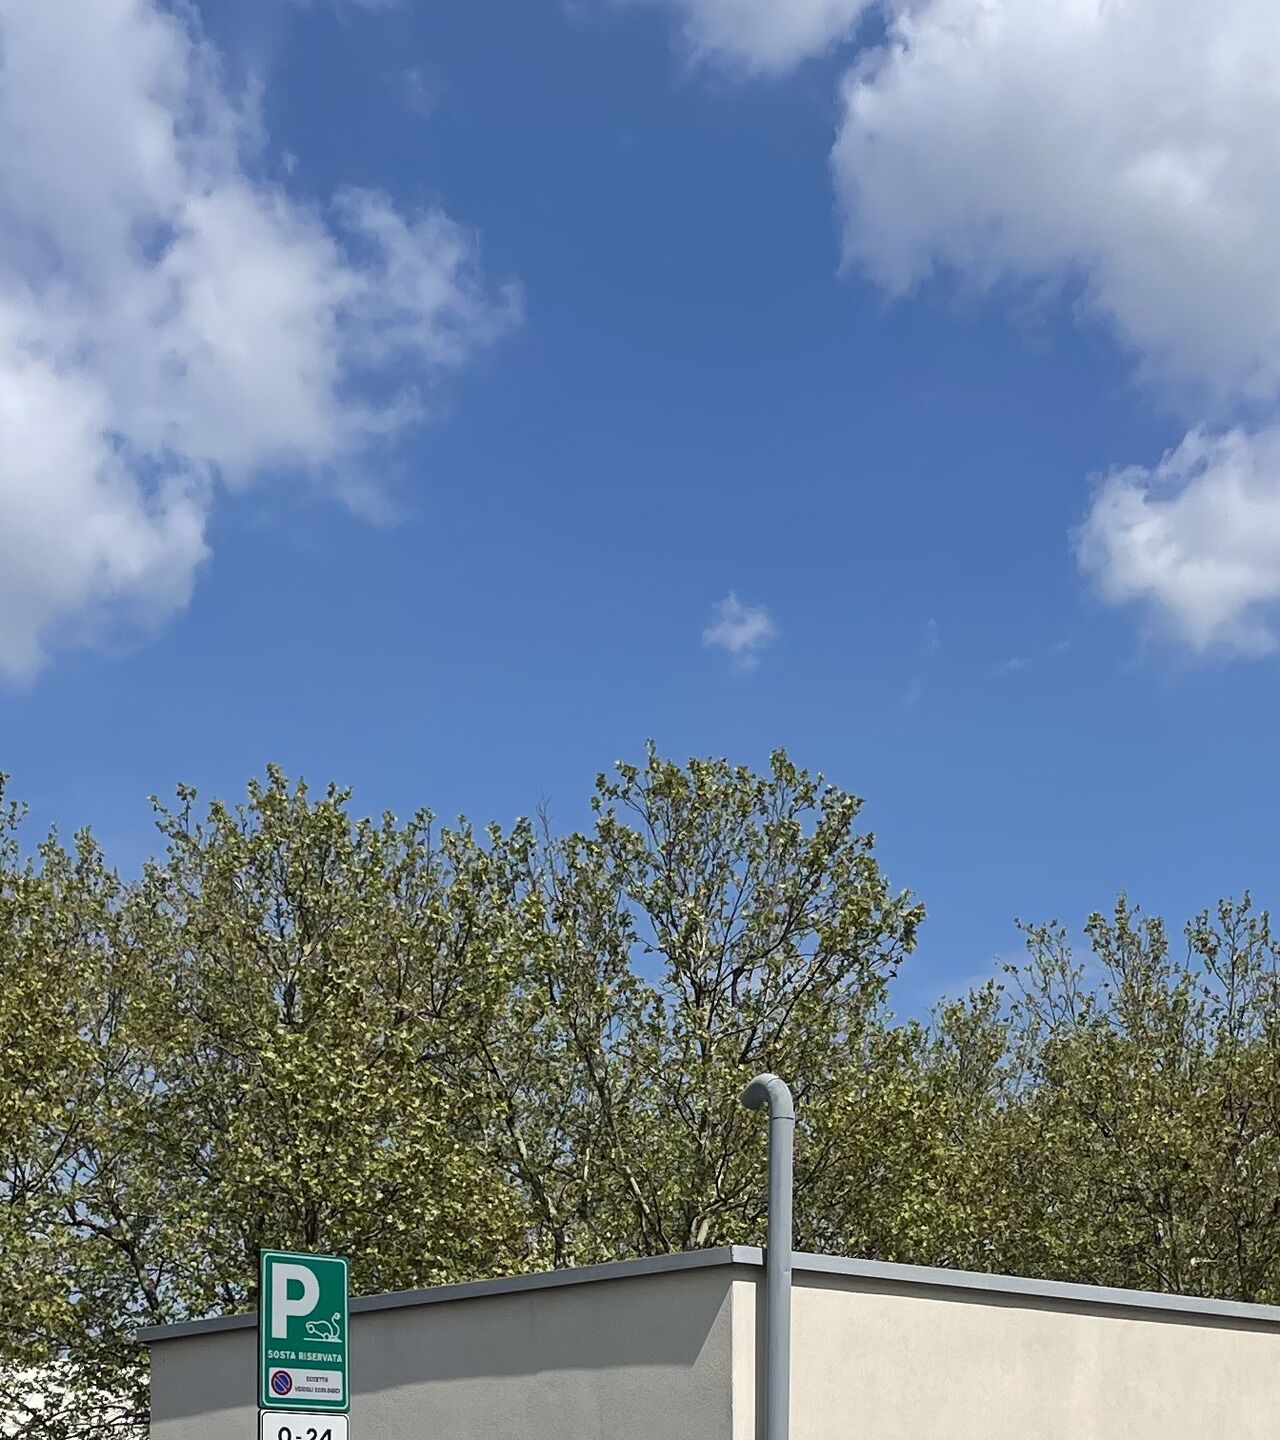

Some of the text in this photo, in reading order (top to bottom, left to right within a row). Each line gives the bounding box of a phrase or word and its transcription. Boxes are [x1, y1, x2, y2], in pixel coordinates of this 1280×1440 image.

[271, 1262, 320, 1339] P
[267, 1350, 343, 1362] SOSTA RISERVATA
